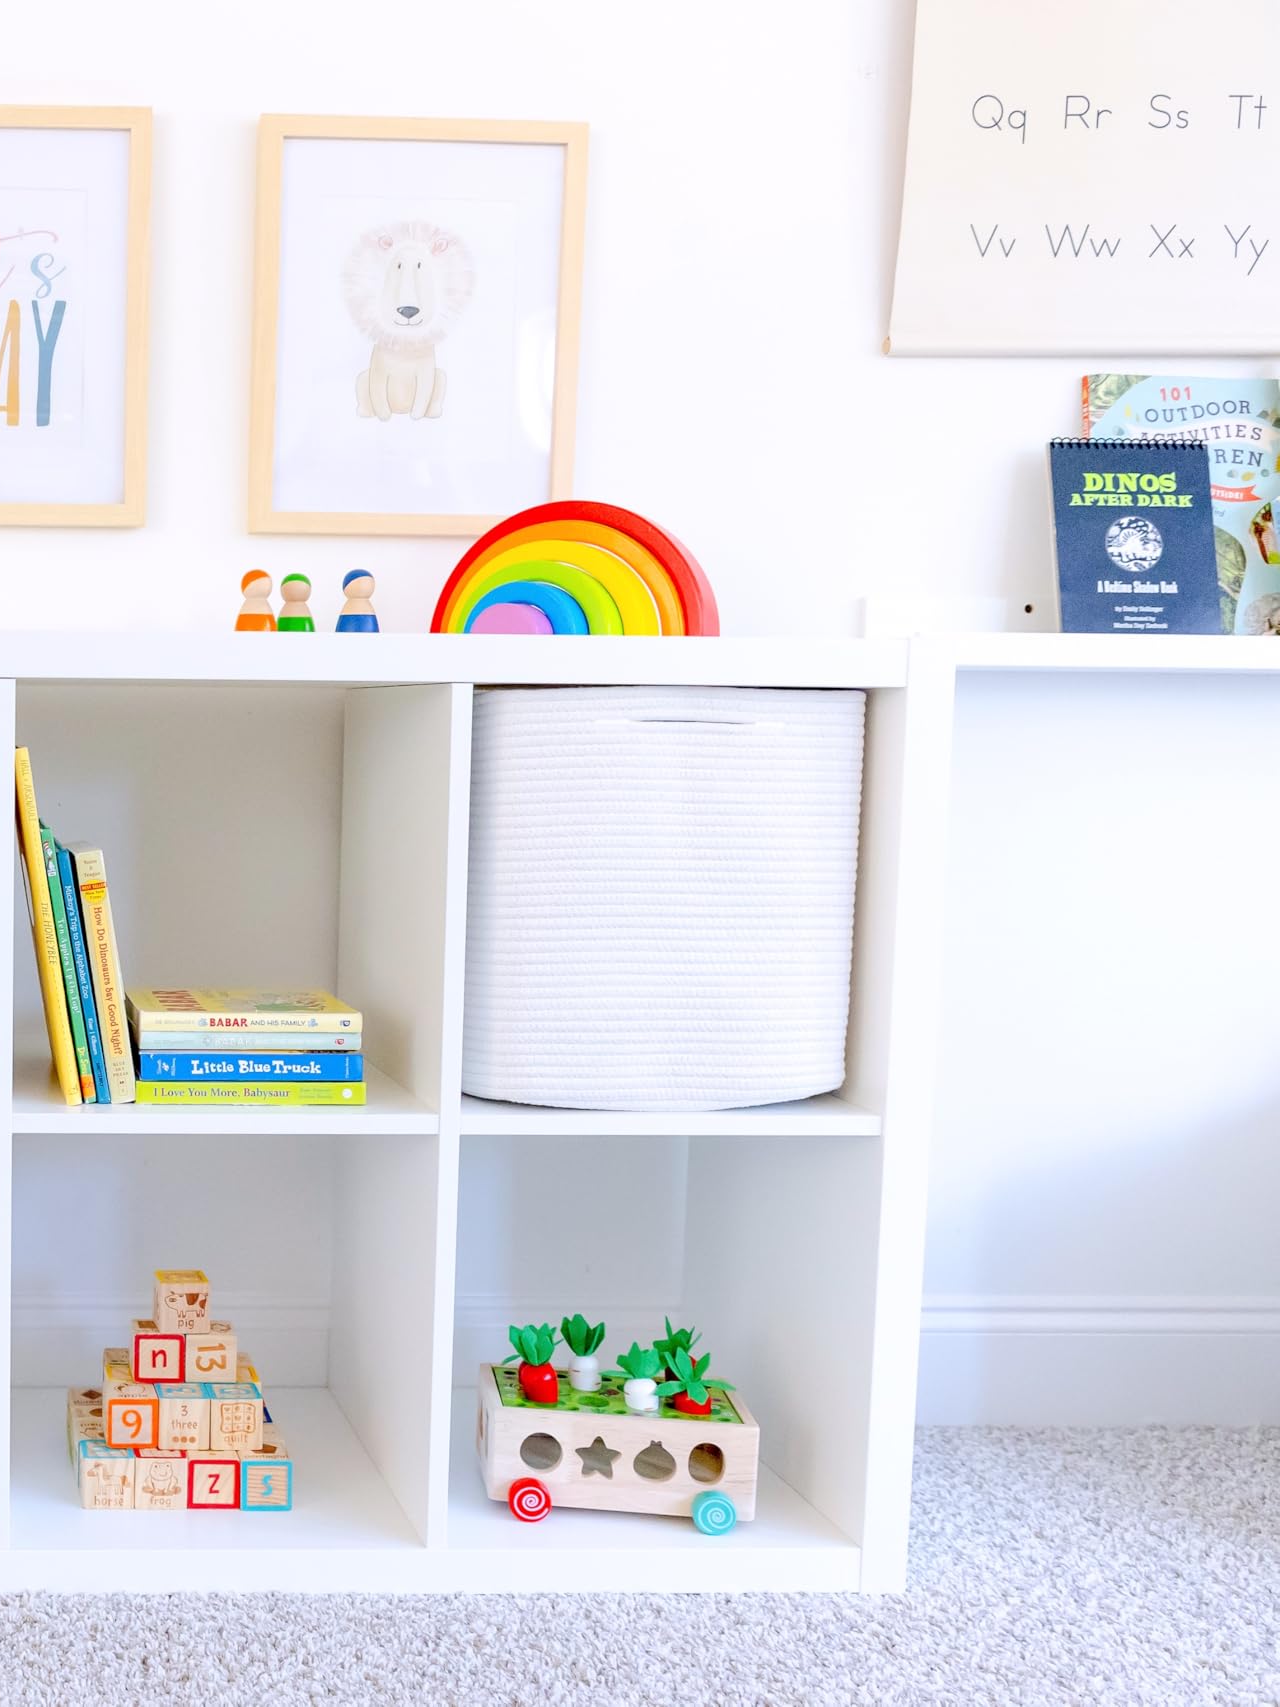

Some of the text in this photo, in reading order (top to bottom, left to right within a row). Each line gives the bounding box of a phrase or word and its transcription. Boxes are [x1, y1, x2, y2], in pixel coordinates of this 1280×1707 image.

[972, 94, 1268, 144] Qq Rr Ss Tt
[970, 223, 1269, 276] Vv Ww Xx Yy
[1160, 386, 1192, 401] 101
[1144, 400, 1252, 423] OUTDOOR
[1082, 471, 1177, 494] DINOS
[1069, 493, 1193, 508] AFTER DARK
[94, 907, 103, 926] How
[44, 920, 58, 966] HONEYBEE
[96, 928, 106, 941] Do
[99, 944, 111, 986] Dinosaurs
[108, 1004, 119, 1027] Good
[209, 1018, 248, 1027] BABAR
[111, 1029, 123, 1055] Night?
[191, 1059, 235, 1075] Little
[238, 1059, 271, 1074] Blue
[272, 1060, 322, 1074] Truck
[154, 1088, 158, 1097] I
[161, 1088, 185, 1097] Love
[188, 1088, 207, 1097] You
[243, 1087, 290, 1100] Babysaur
[177, 1318, 195, 1330] pig
[195, 1342, 227, 1373] 13
[180, 1404, 189, 1417] 3
[121, 1409, 143, 1439] 9
[171, 1419, 199, 1431] three
[94, 1495, 124, 1508] horse
[149, 1495, 172, 1508] frog
